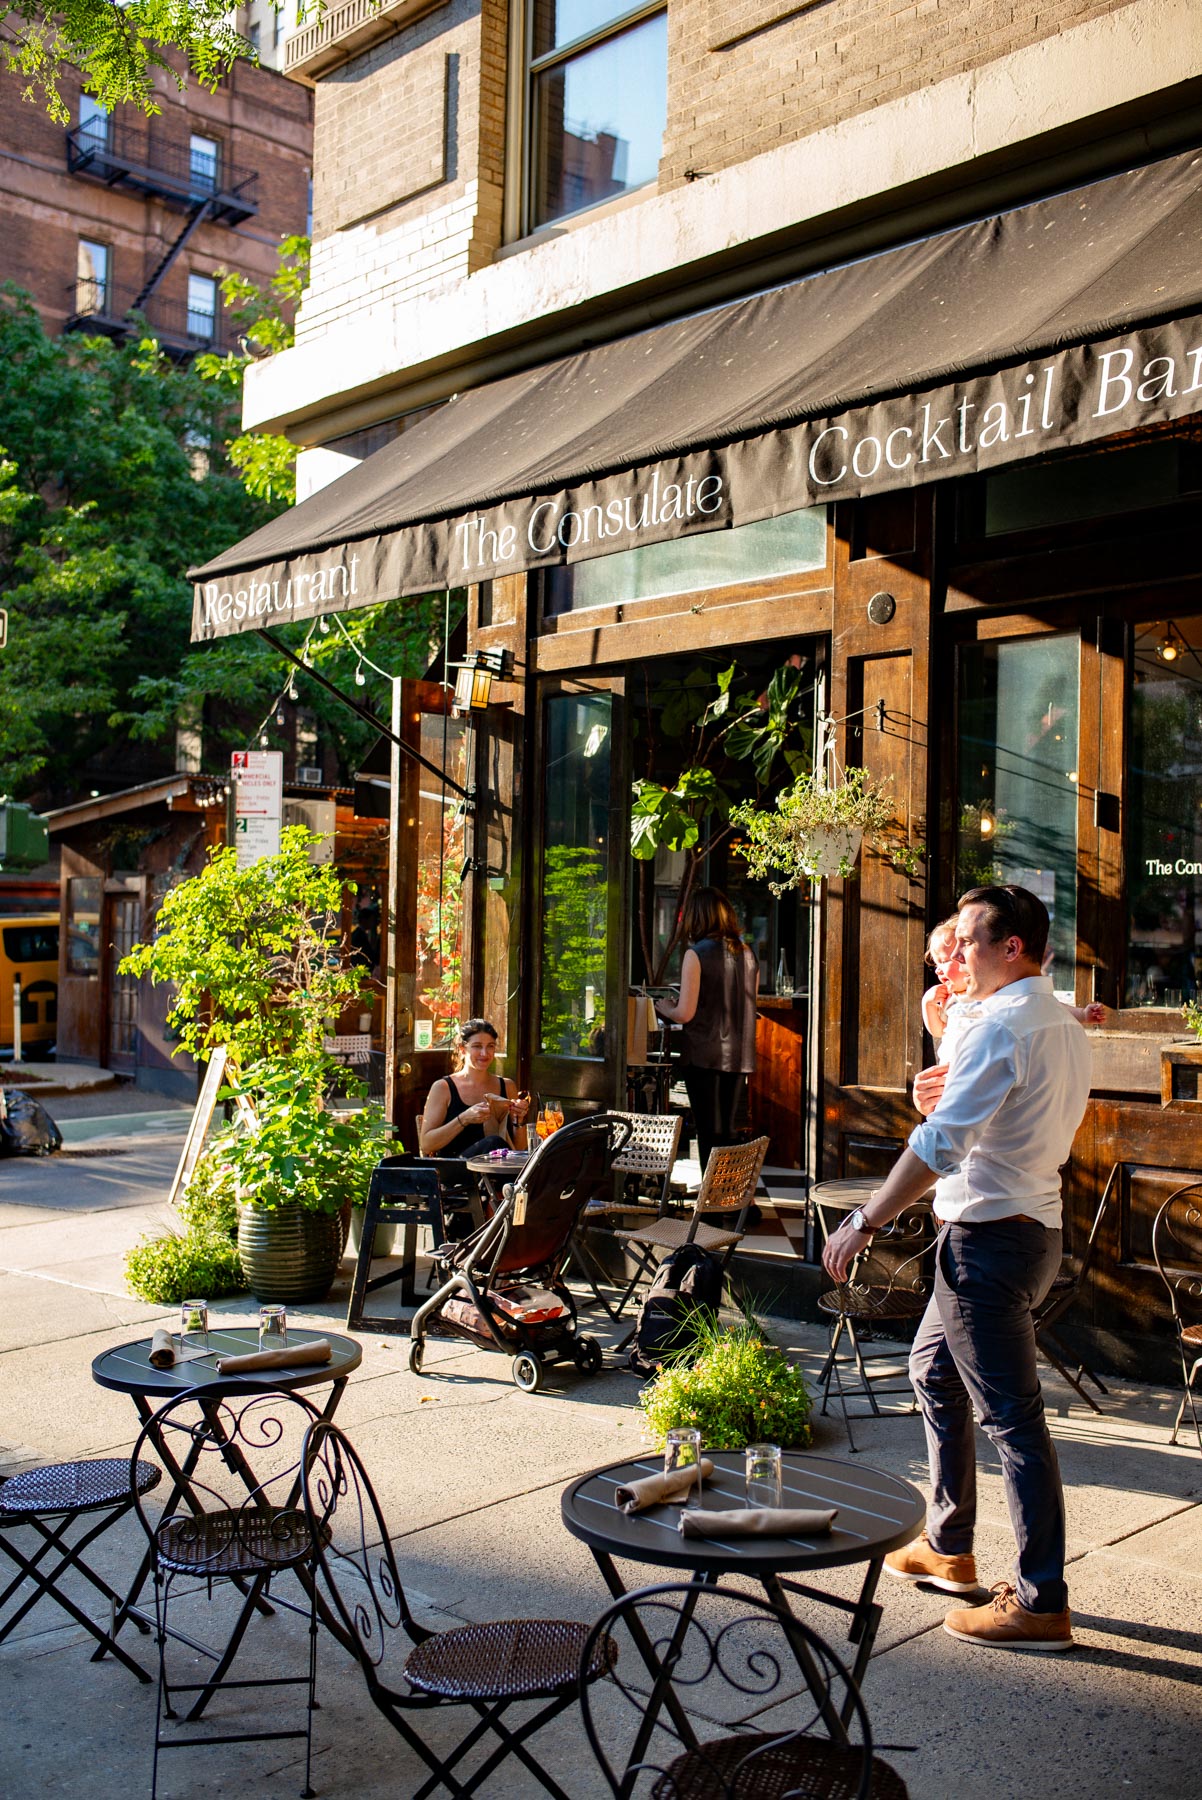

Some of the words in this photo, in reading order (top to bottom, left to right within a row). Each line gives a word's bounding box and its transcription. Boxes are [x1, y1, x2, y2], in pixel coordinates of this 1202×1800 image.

[201, 552, 361, 627] Restaurant
[455, 515, 517, 570] The
[527, 471, 723, 553] Consulate
[808, 364, 1055, 486] Cocktail
[236, 819, 245, 832] 2
[1145, 859, 1173, 876] The
[1175, 859, 1202, 875] Con
